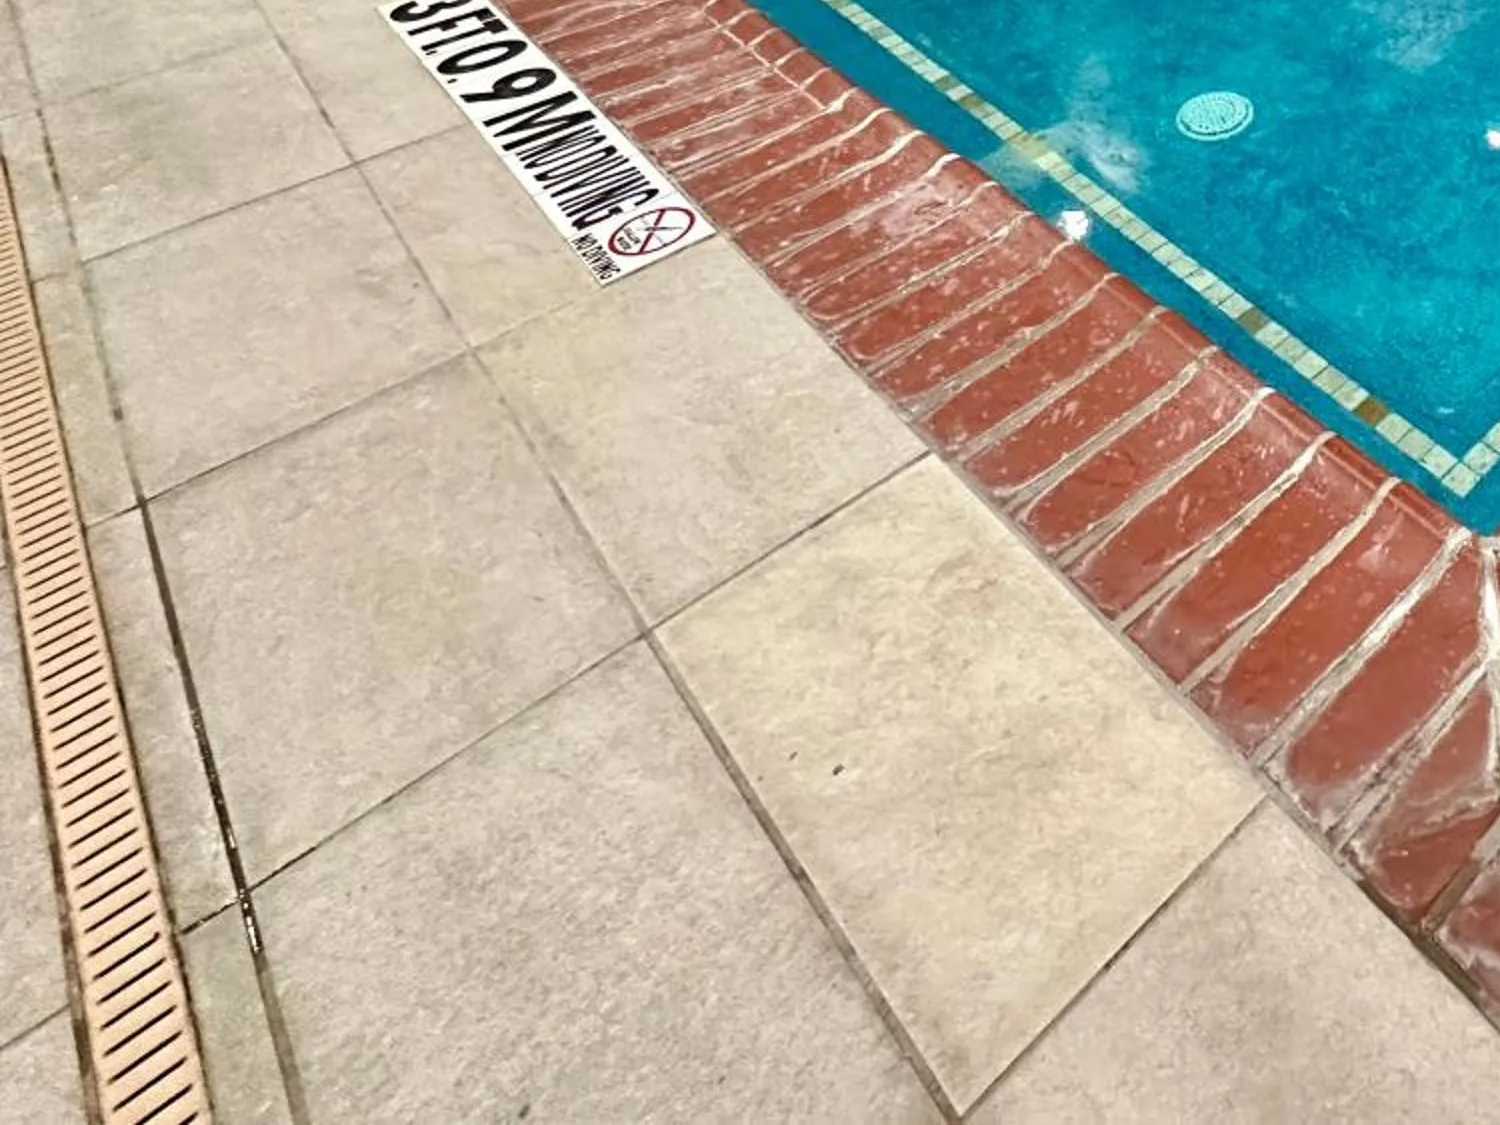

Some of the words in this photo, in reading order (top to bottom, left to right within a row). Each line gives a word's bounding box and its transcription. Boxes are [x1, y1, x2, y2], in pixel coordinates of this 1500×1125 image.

[483, 90, 597, 152] M
[515, 125, 607, 169] NO
[534, 145, 660, 231] DIVING
